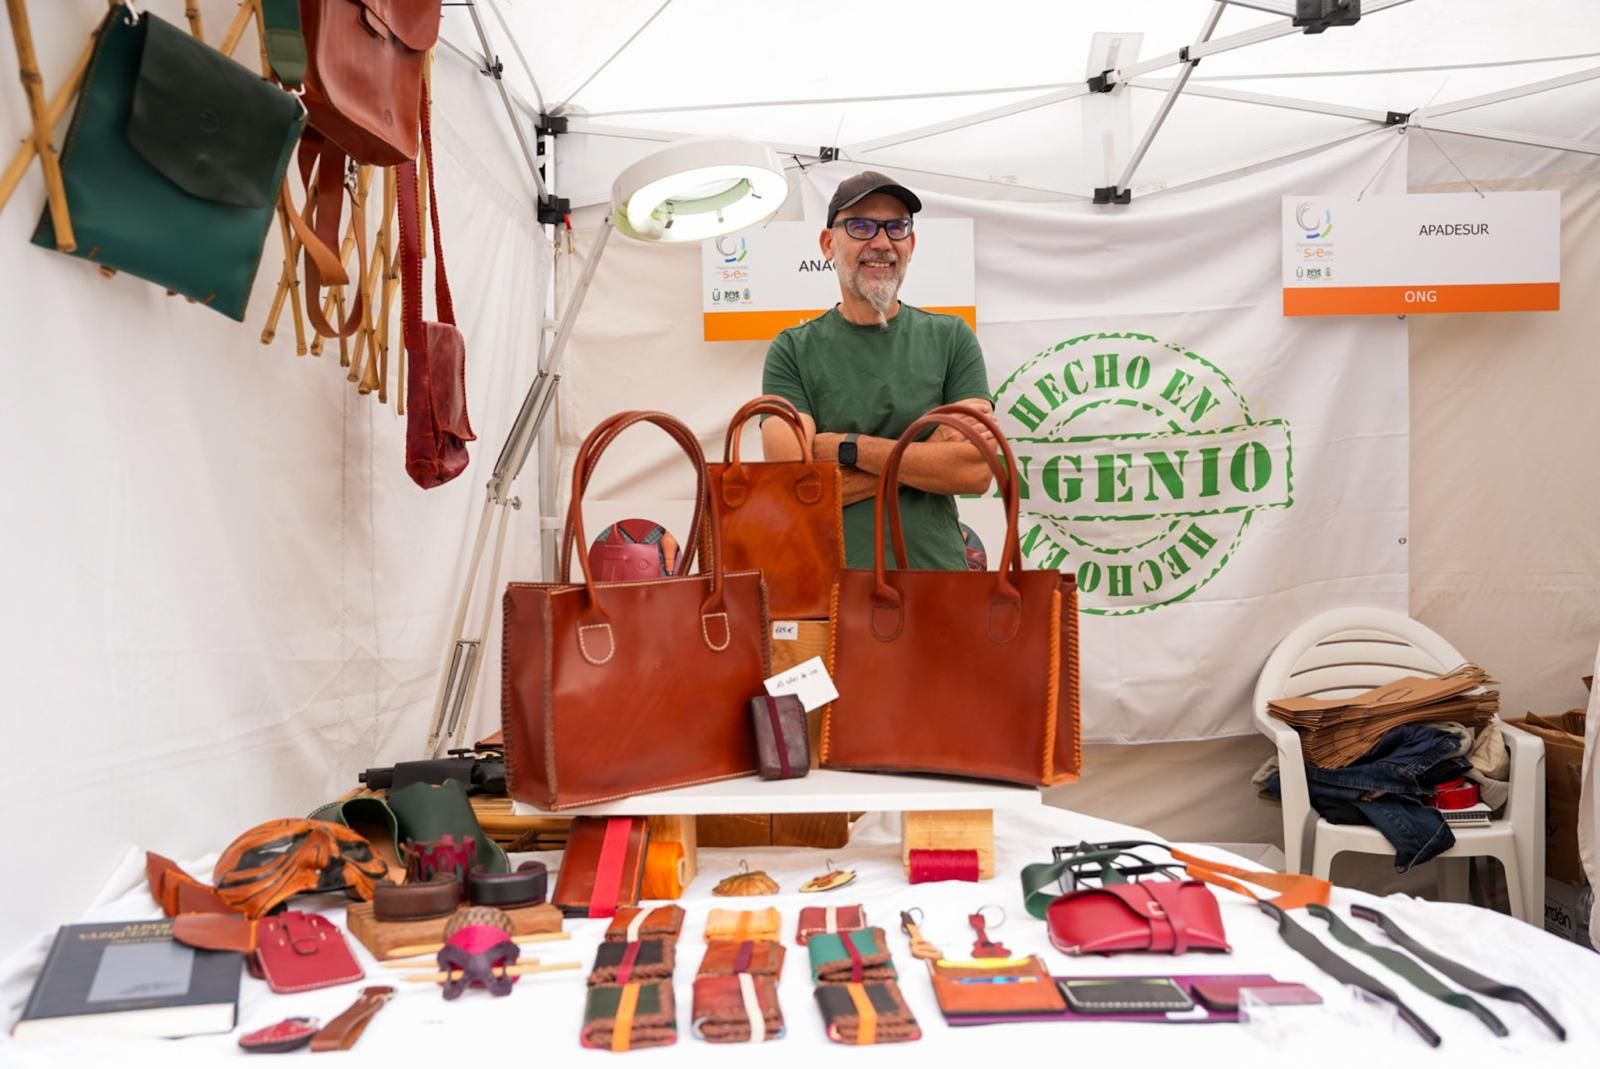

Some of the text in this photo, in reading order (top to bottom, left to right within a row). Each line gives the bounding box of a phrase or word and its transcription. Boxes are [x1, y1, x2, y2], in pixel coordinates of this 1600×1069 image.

[1419, 223, 1489, 236] APADESUR
[1404, 290, 1437, 303] ONG
[1008, 353, 1221, 433] HECHO EN
[960, 440, 1272, 503] NGENIO
[1077, 522, 1218, 597] HECHO
